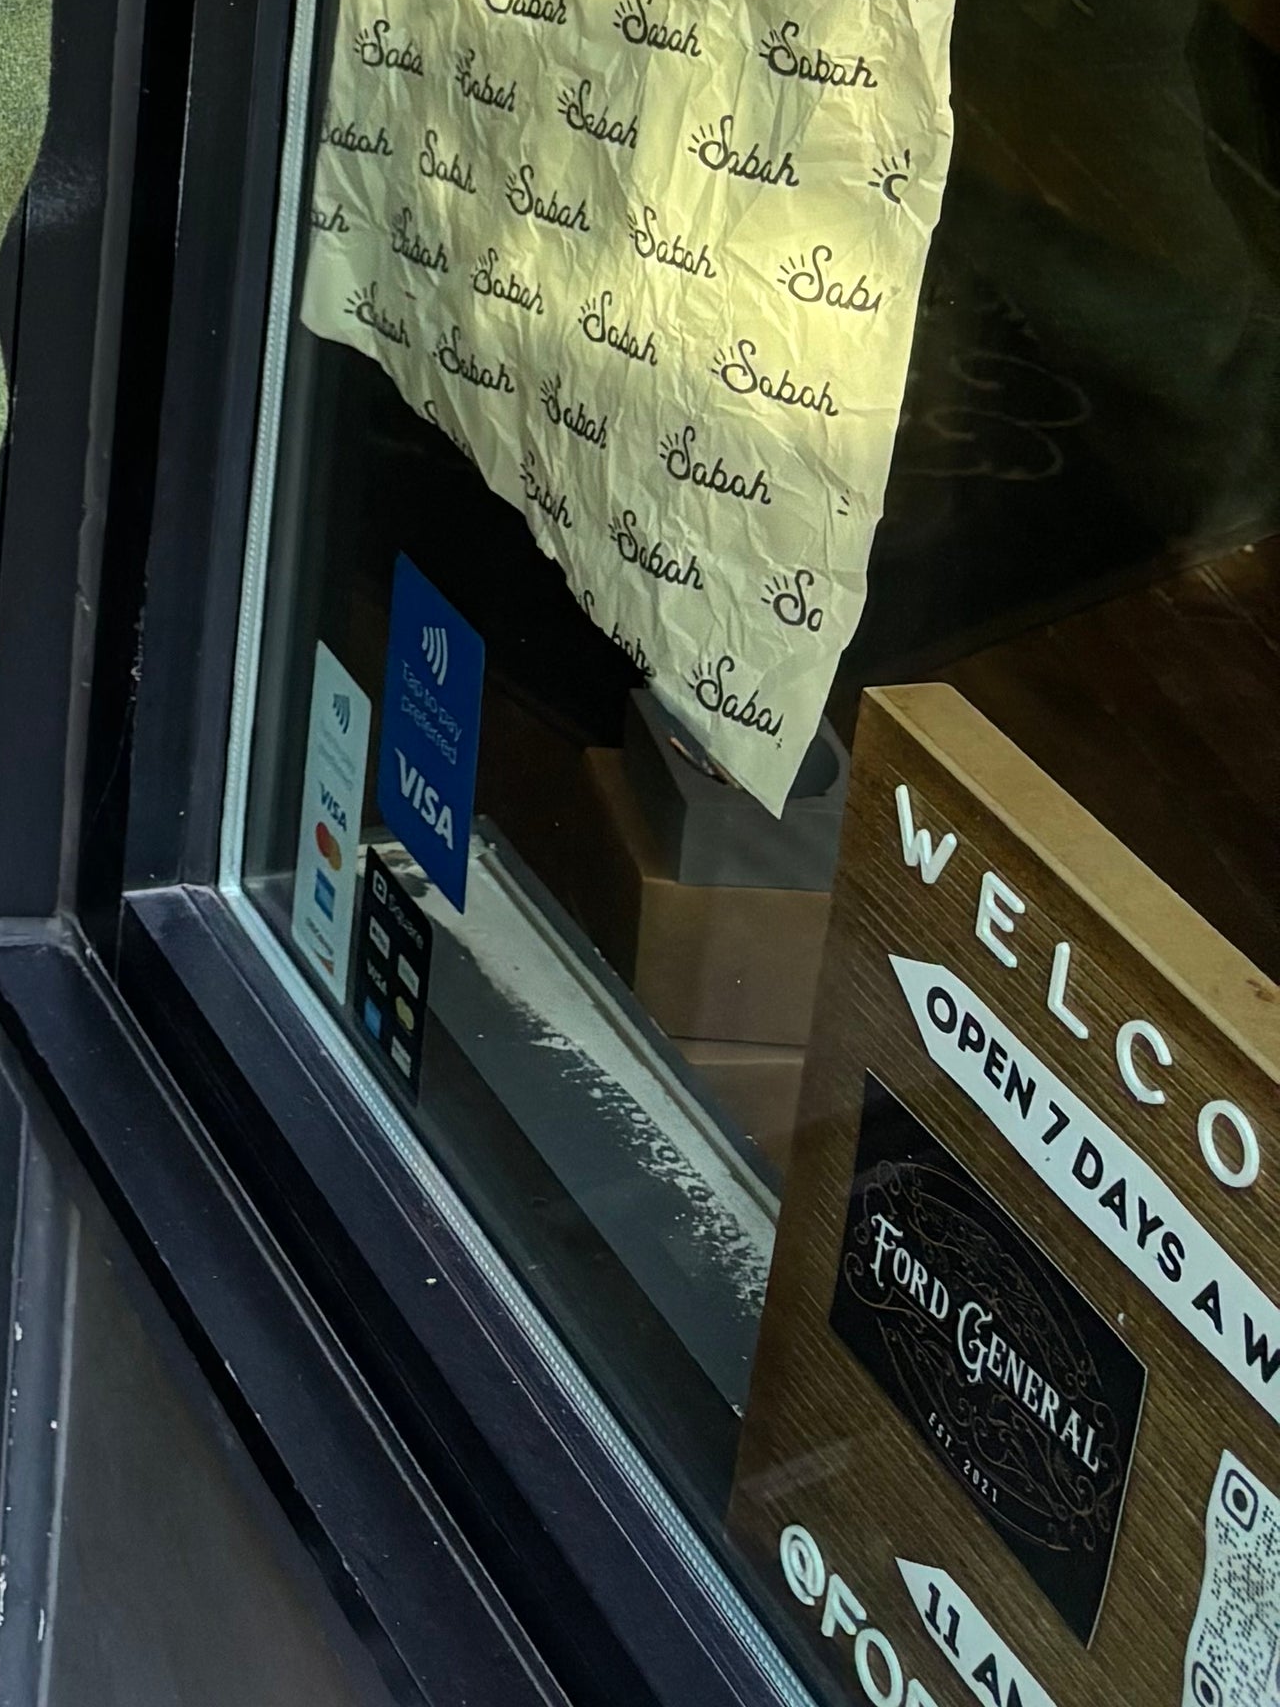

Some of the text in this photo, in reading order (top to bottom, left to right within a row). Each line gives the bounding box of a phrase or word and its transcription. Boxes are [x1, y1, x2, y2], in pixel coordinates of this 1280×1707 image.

[767, 21, 878, 88] Sabah
[698, 114, 800, 188] Sabah
[507, 164, 590, 233] Sabah
[634, 206, 717, 279] Sabah
[473, 248, 544, 315] Sabah
[582, 291, 658, 367] Sabah
[721, 339, 839, 417] Sabah
[667, 426, 771, 505] Sabah
[616, 510, 704, 590] Sabah
[319, 779, 348, 833] VISA
[394, 747, 454, 851] VISA
[895, 784, 1261, 1189] WELCO
[924, 986, 1038, 1120] OPEN
[1039, 1098, 1070, 1154] 7
[1071, 1141, 1186, 1284] DAYS
[1191, 1280, 1225, 1336] A
[868, 1213, 1103, 1476] FORD GENERAL
[962, 1459, 999, 1504] 2021
[926, 1581, 961, 1658] 11
